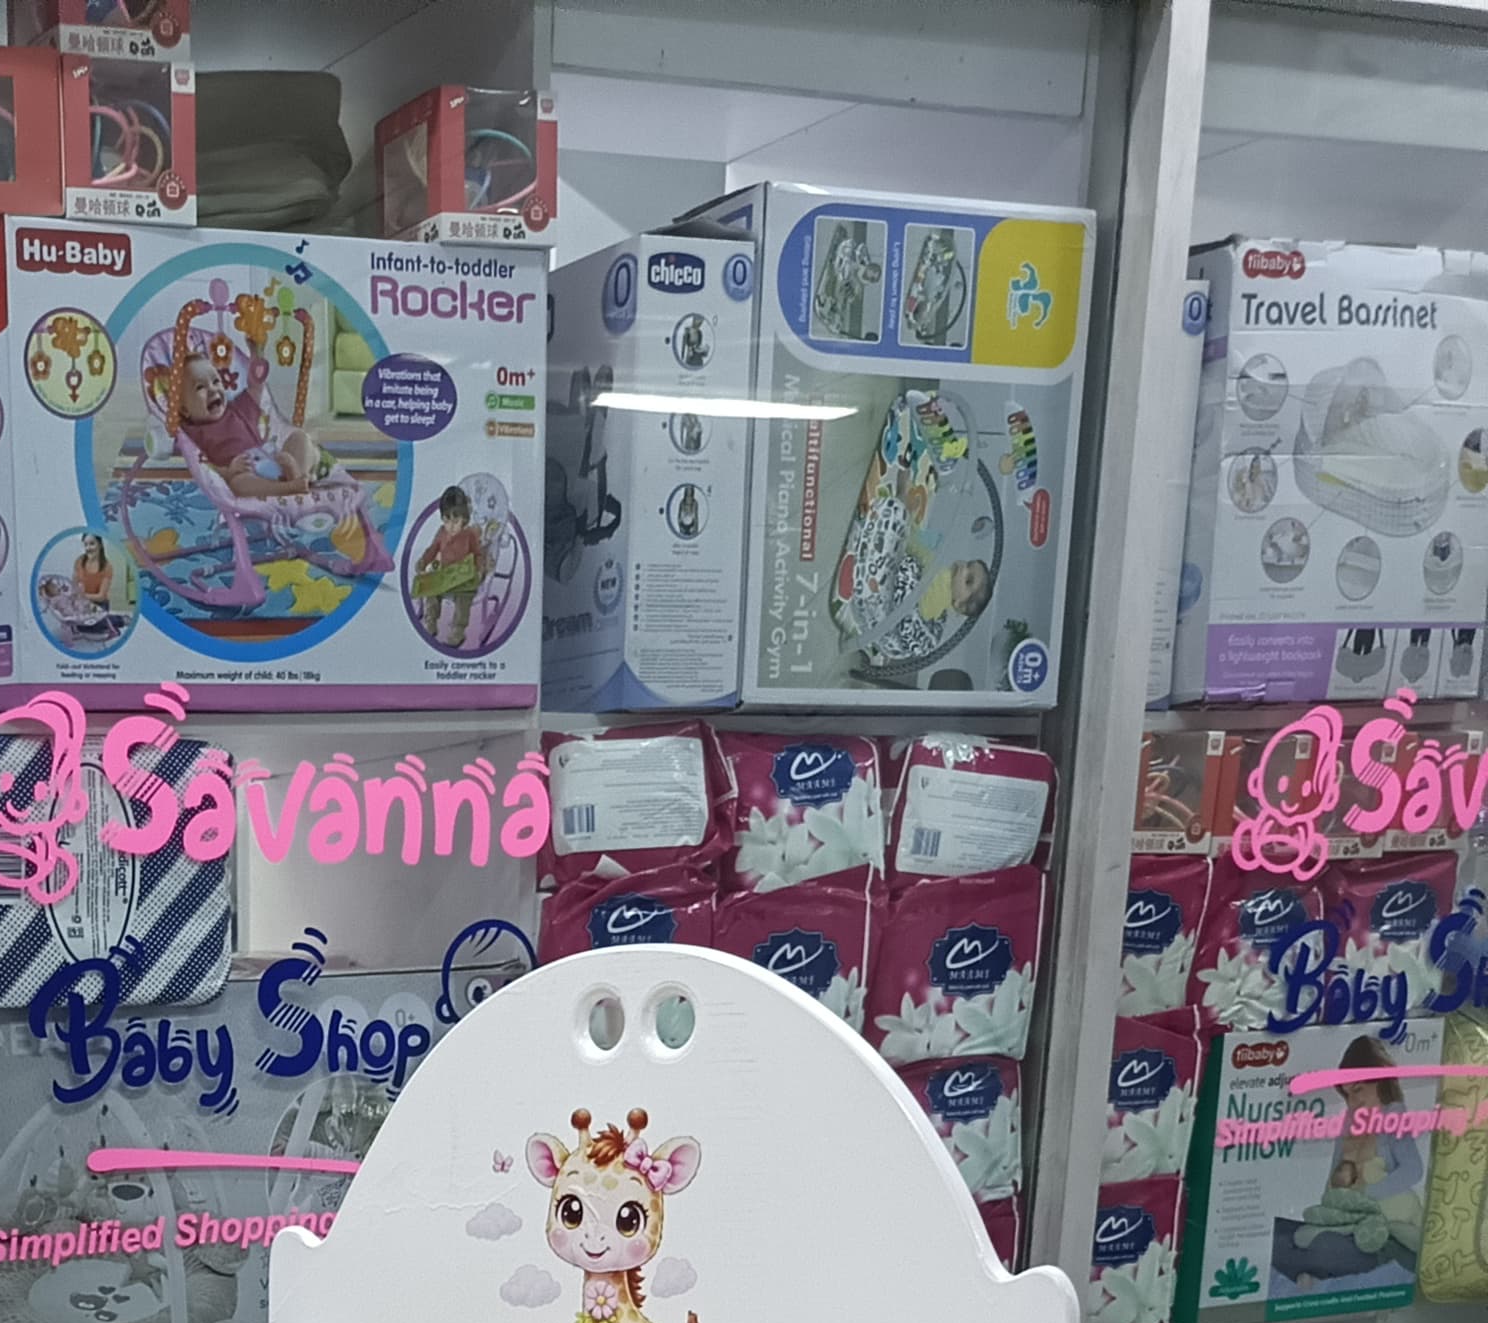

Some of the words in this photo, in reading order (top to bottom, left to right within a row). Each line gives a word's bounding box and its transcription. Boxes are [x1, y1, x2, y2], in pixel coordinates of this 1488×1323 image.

[23, 238, 126, 270] Hu-Baby
[371, 252, 515, 278] Infant-to-toddler
[650, 257, 702, 286] chicco
[370, 275, 536, 324] Rocker
[1241, 293, 1327, 325] Travel
[1338, 295, 1437, 329] Bassinet
[423, 370, 441, 382] that
[777, 471, 796, 531] Piano
[801, 399, 821, 560] ultifunctional
[769, 534, 791, 620] Activity
[791, 572, 819, 673] 7-in-1
[767, 627, 787, 679] Gym
[102, 714, 550, 867] Savanna
[1267, 920, 1408, 1040] Baby
[29, 957, 234, 1107] Baby
[257, 957, 430, 1088] Shop
[1215, 1109, 1346, 1148] Simplified
[1350, 1105, 1468, 1138] Shopping
